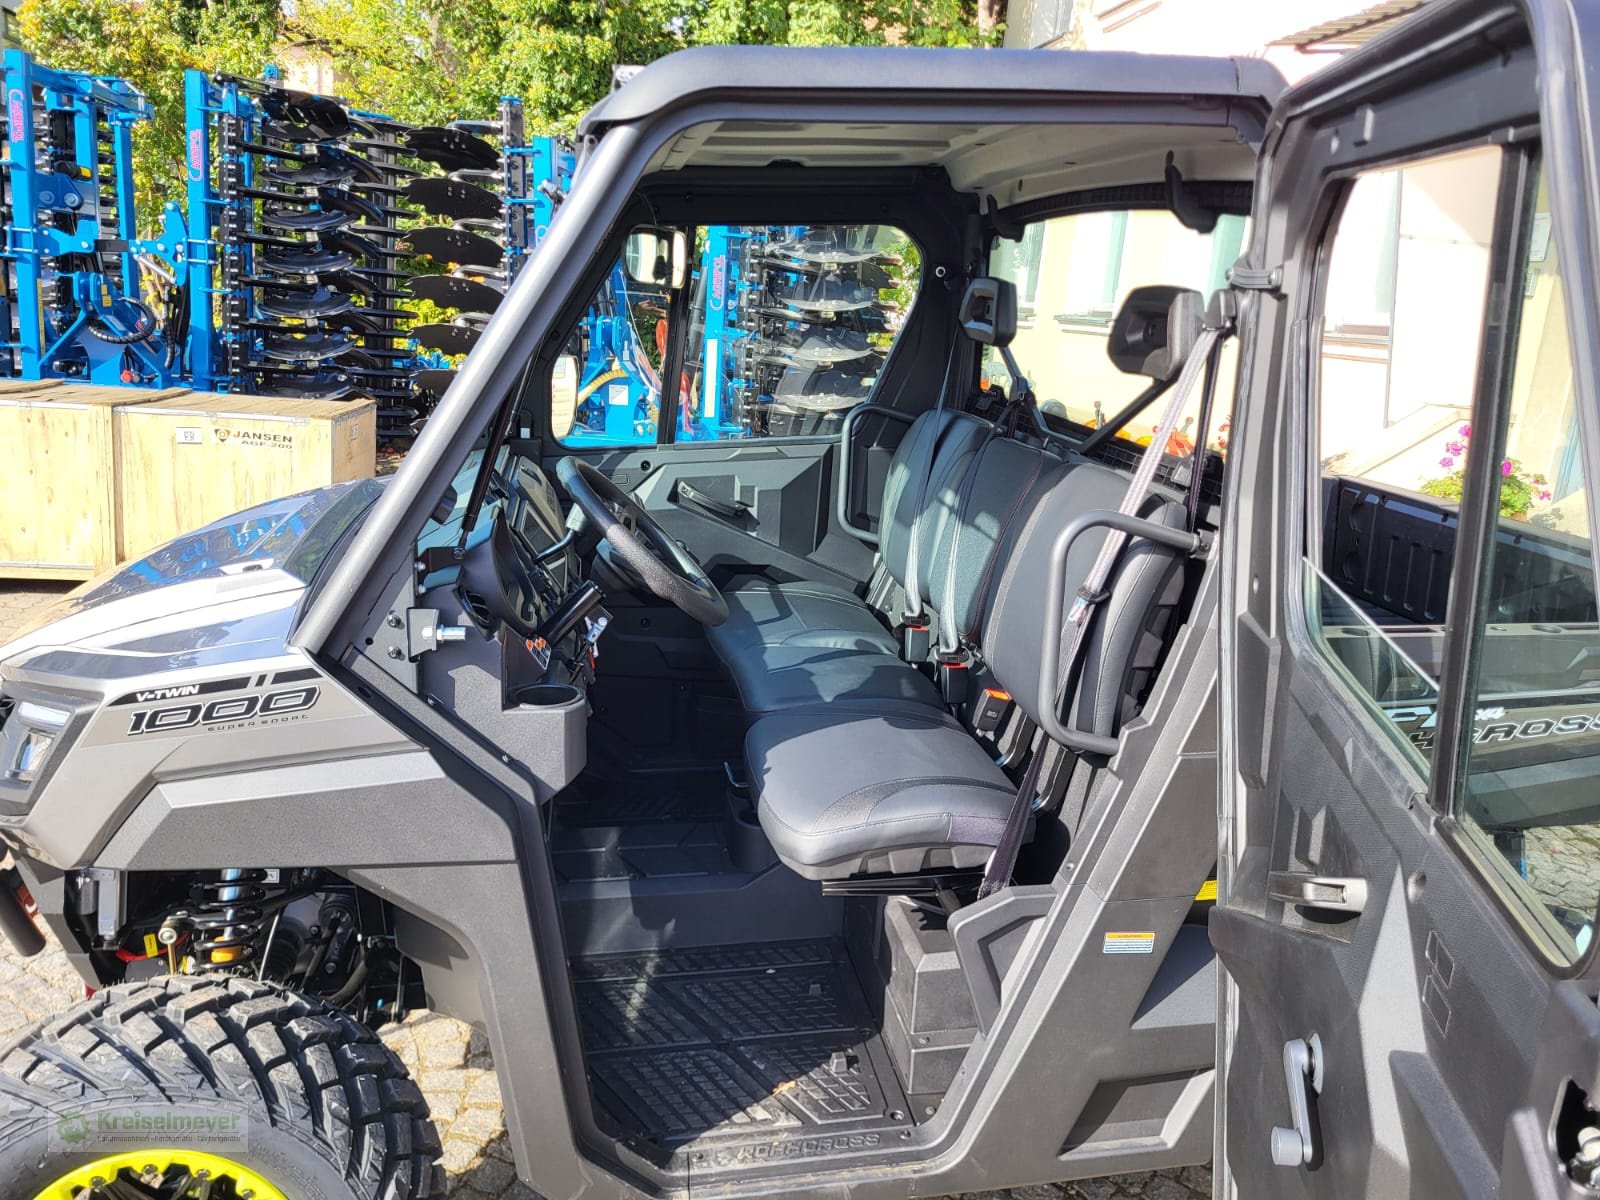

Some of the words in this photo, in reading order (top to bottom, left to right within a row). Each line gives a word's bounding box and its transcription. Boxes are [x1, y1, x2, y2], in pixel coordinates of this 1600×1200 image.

[233, 430, 292, 443] JANSEN
[136, 684, 200, 702] V-TWIN
[128, 685, 320, 735] 1000
[207, 721, 255, 732] SUPER
[261, 714, 309, 725] SPORT
